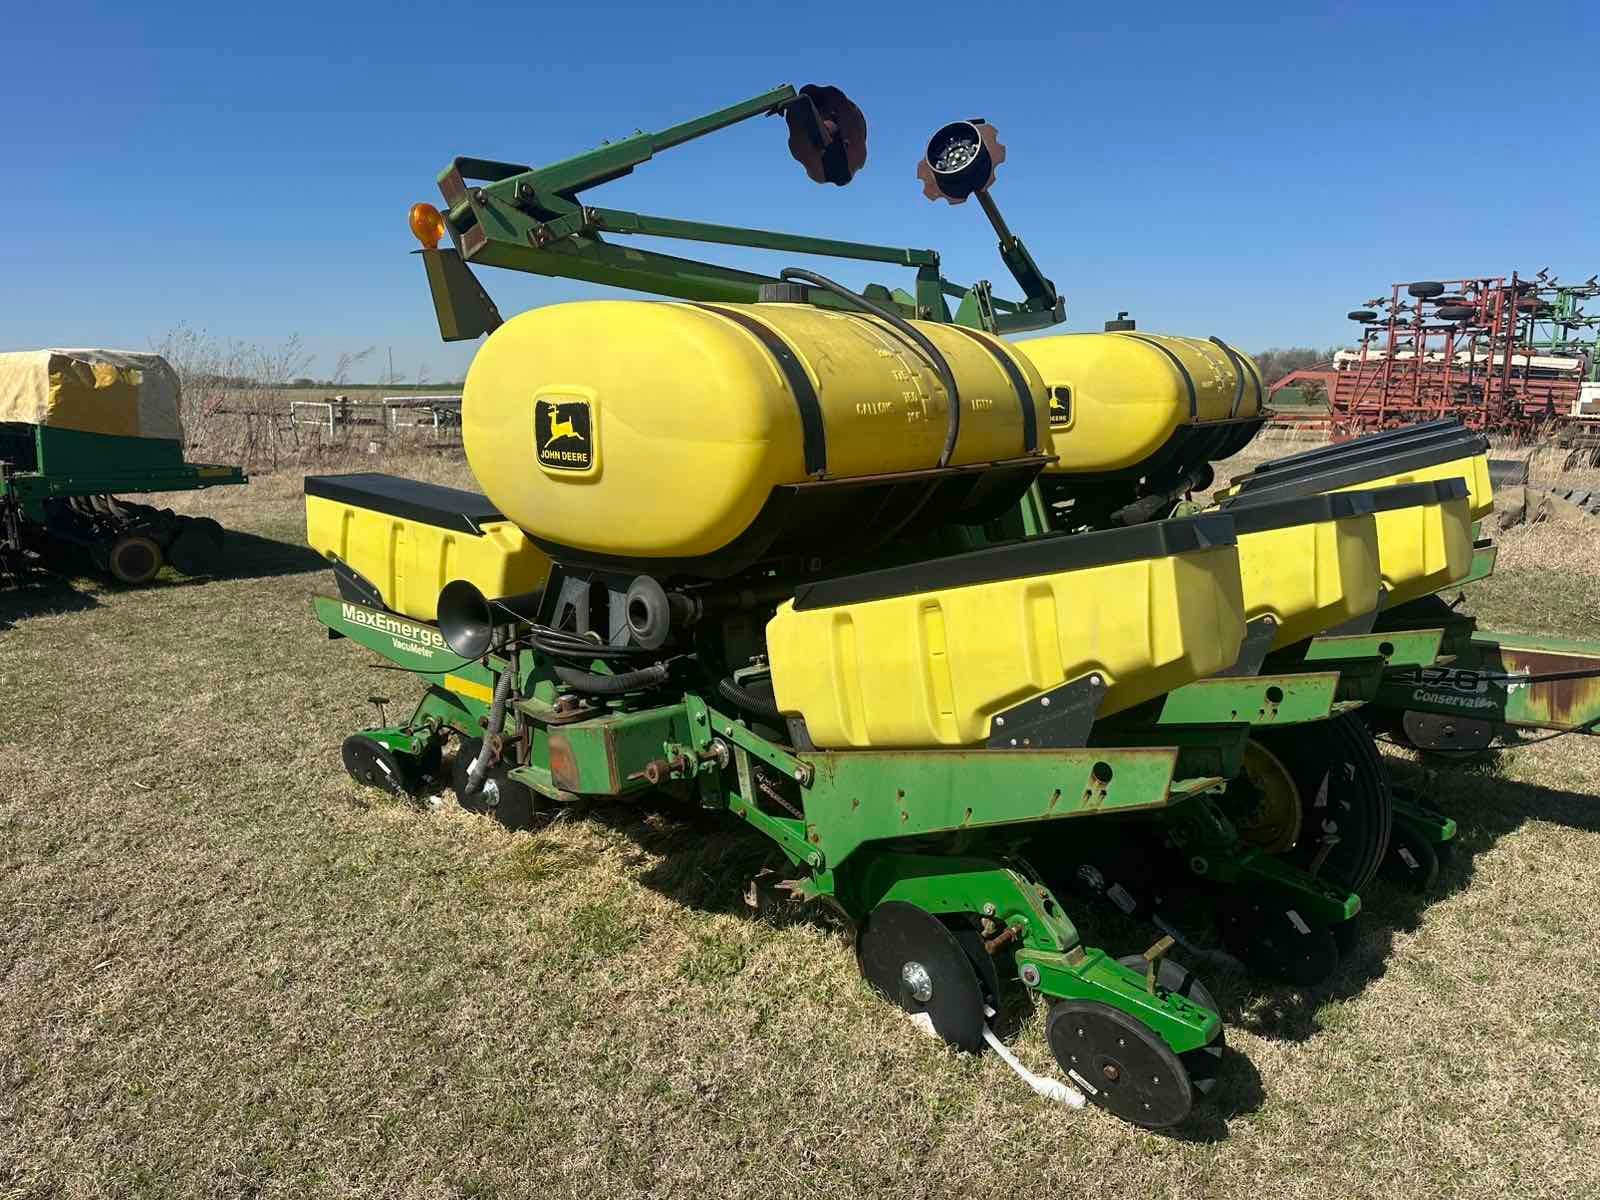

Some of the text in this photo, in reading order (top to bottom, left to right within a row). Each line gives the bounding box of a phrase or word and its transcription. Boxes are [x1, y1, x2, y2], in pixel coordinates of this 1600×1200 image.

[540, 449, 589, 463] JOHN DEERE
[391, 637, 435, 658] VacuMeter
